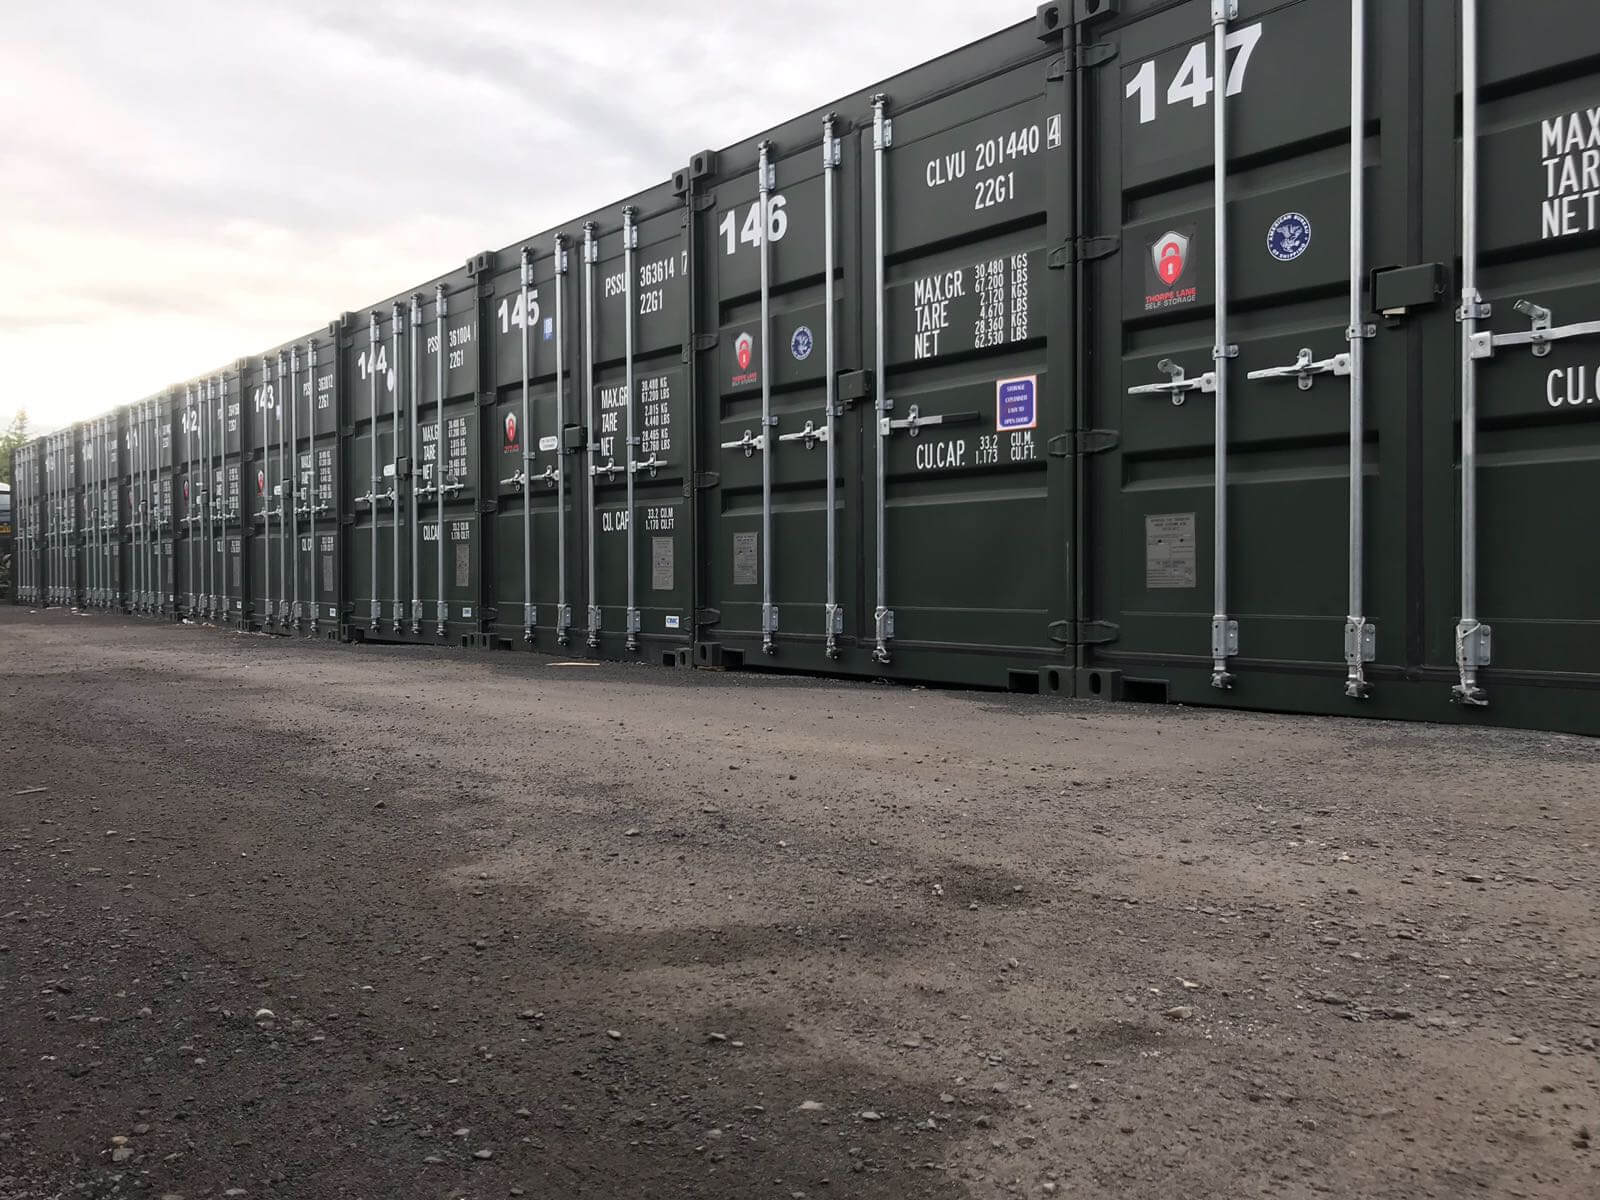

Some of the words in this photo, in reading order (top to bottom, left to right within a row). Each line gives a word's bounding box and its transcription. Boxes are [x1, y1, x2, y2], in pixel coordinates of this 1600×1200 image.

[1126, 22, 1262, 124] 147
[926, 150, 966, 187] CLVU
[975, 125, 1040, 171] 201440
[1049, 115, 1061, 148] 4
[974, 172, 1014, 210] 22G1
[719, 194, 788, 255] 146
[1541, 189, 1600, 240] NET
[640, 256, 674, 288] 363614
[914, 270, 966, 307] MAX.GR.
[975, 258, 1004, 279] 30.480
[1011, 253, 1028, 270] KGS
[975, 273, 1004, 293] 67.200
[1011, 268, 1028, 285] LBS
[498, 289, 540, 334] 145
[640, 288, 663, 315] 22G1
[915, 300, 949, 333] TARE
[980, 287, 1004, 306] 2.120
[1011, 282, 1028, 299] KGS
[980, 302, 1004, 320] 4.670
[1011, 297, 1028, 313] LBS
[914, 329, 941, 359] NET
[975, 316, 1004, 335] 28.360
[1011, 311, 1028, 328] KGS
[975, 330, 1004, 349] 62.530
[1011, 326, 1028, 342] LBS
[125, 428, 138, 450] 11
[182, 410, 198, 434] 12
[601, 412, 618, 433] TARE
[601, 436, 614, 457] NET
[916, 439, 965, 470] CU.CAP.
[980, 434, 998, 450] 33.2
[975, 449, 998, 465] 1.173
